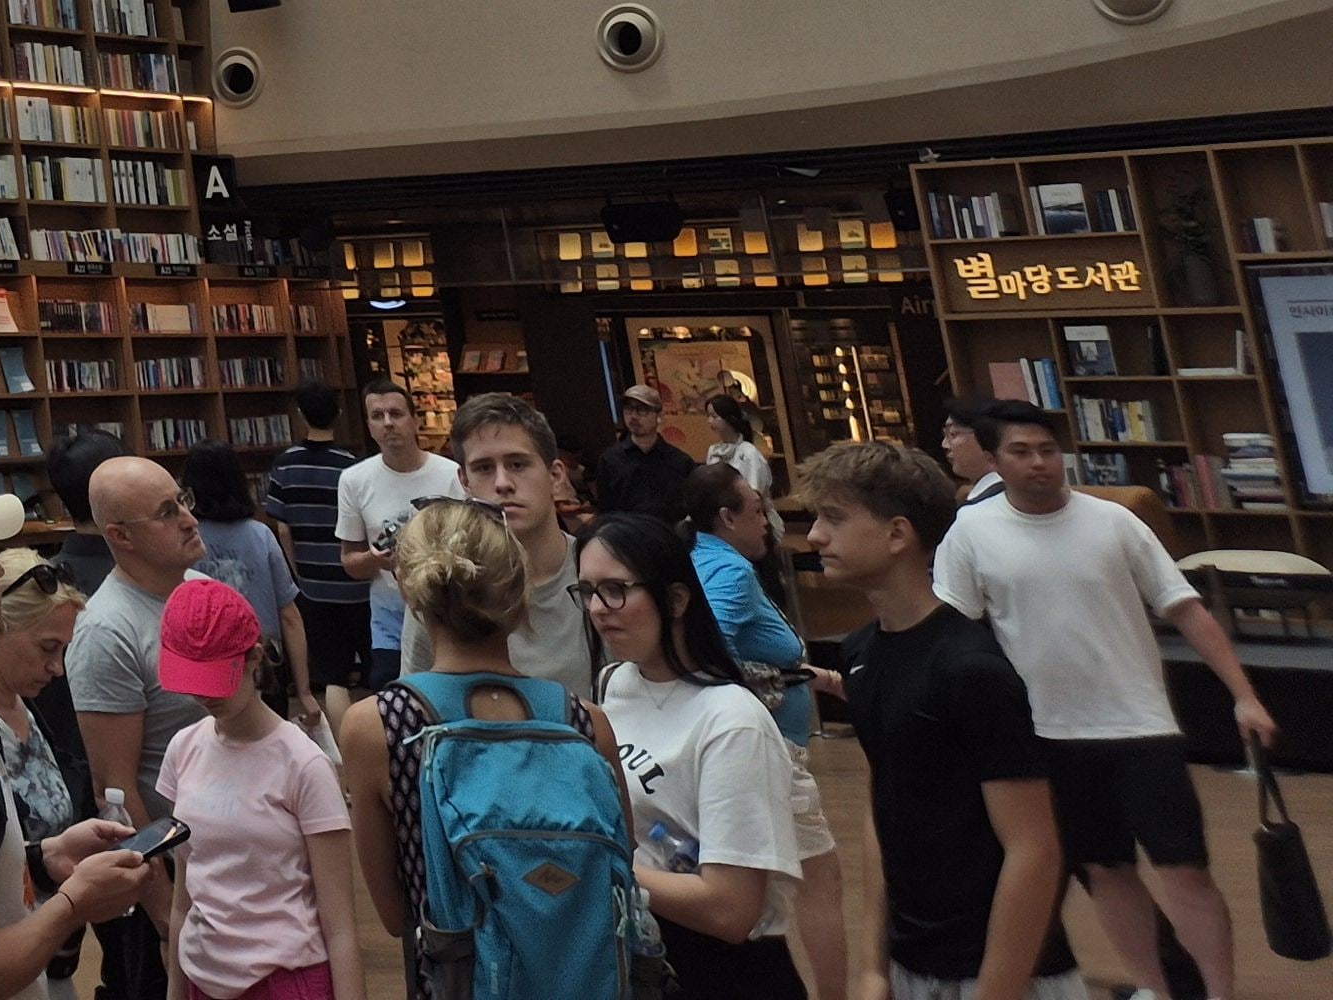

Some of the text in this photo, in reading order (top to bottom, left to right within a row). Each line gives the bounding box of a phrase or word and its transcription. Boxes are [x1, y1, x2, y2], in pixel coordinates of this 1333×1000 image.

[205, 165, 230, 199] A
[207, 223, 238, 242] 소설
[243, 220, 254, 252] Fiction
[1289, 305, 1333, 319] 인사이
[617, 743, 665, 795] OUL
